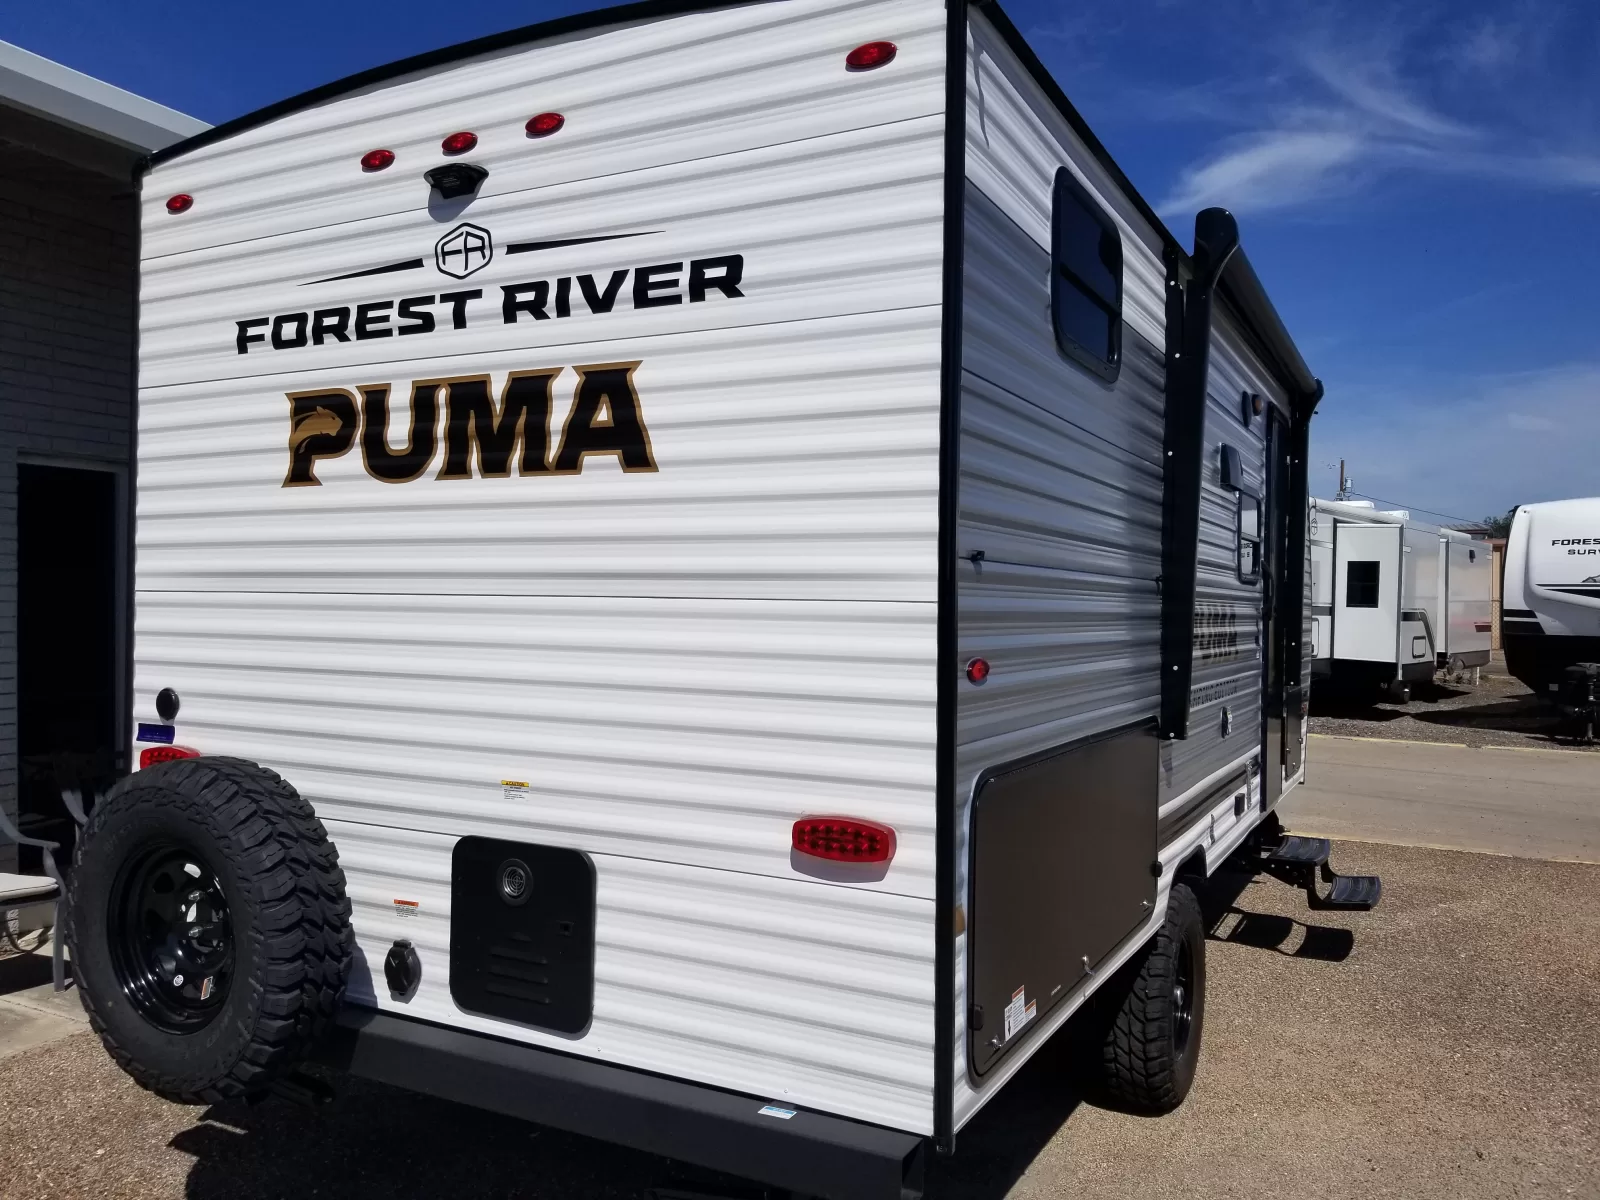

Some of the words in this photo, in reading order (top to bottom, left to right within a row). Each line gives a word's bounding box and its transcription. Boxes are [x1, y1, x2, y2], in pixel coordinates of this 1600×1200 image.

[235, 289, 483, 355] FOREST
[500, 254, 745, 325] RIVER
[282, 360, 660, 488] PUMA
